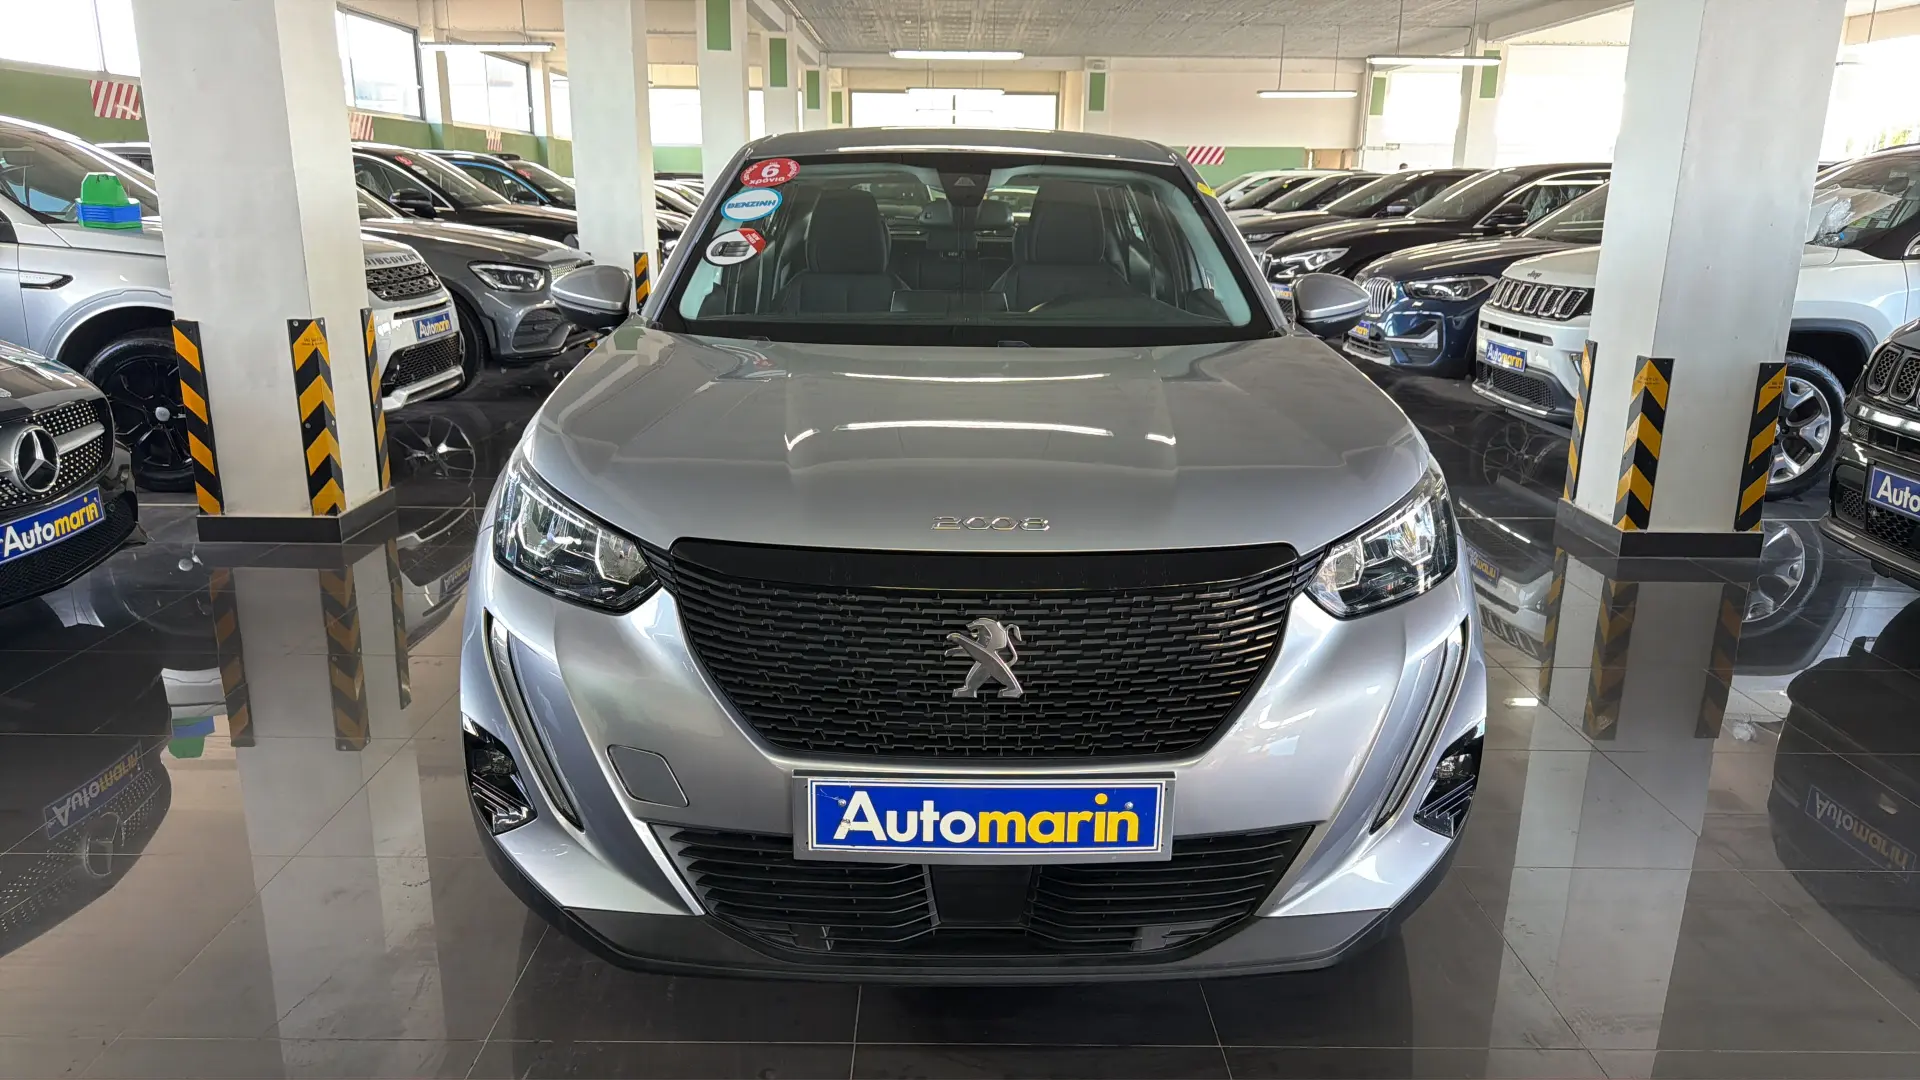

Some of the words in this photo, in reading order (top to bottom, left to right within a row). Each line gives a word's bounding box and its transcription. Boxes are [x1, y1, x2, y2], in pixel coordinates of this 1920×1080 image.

[761, 164, 780, 178] 6
[420, 315, 450, 338] Automarin
[1487, 343, 1523, 369] Automarin
[4, 496, 99, 557] Automarin
[931, 516, 1050, 531] 2008
[833, 790, 1139, 843] Automarin
